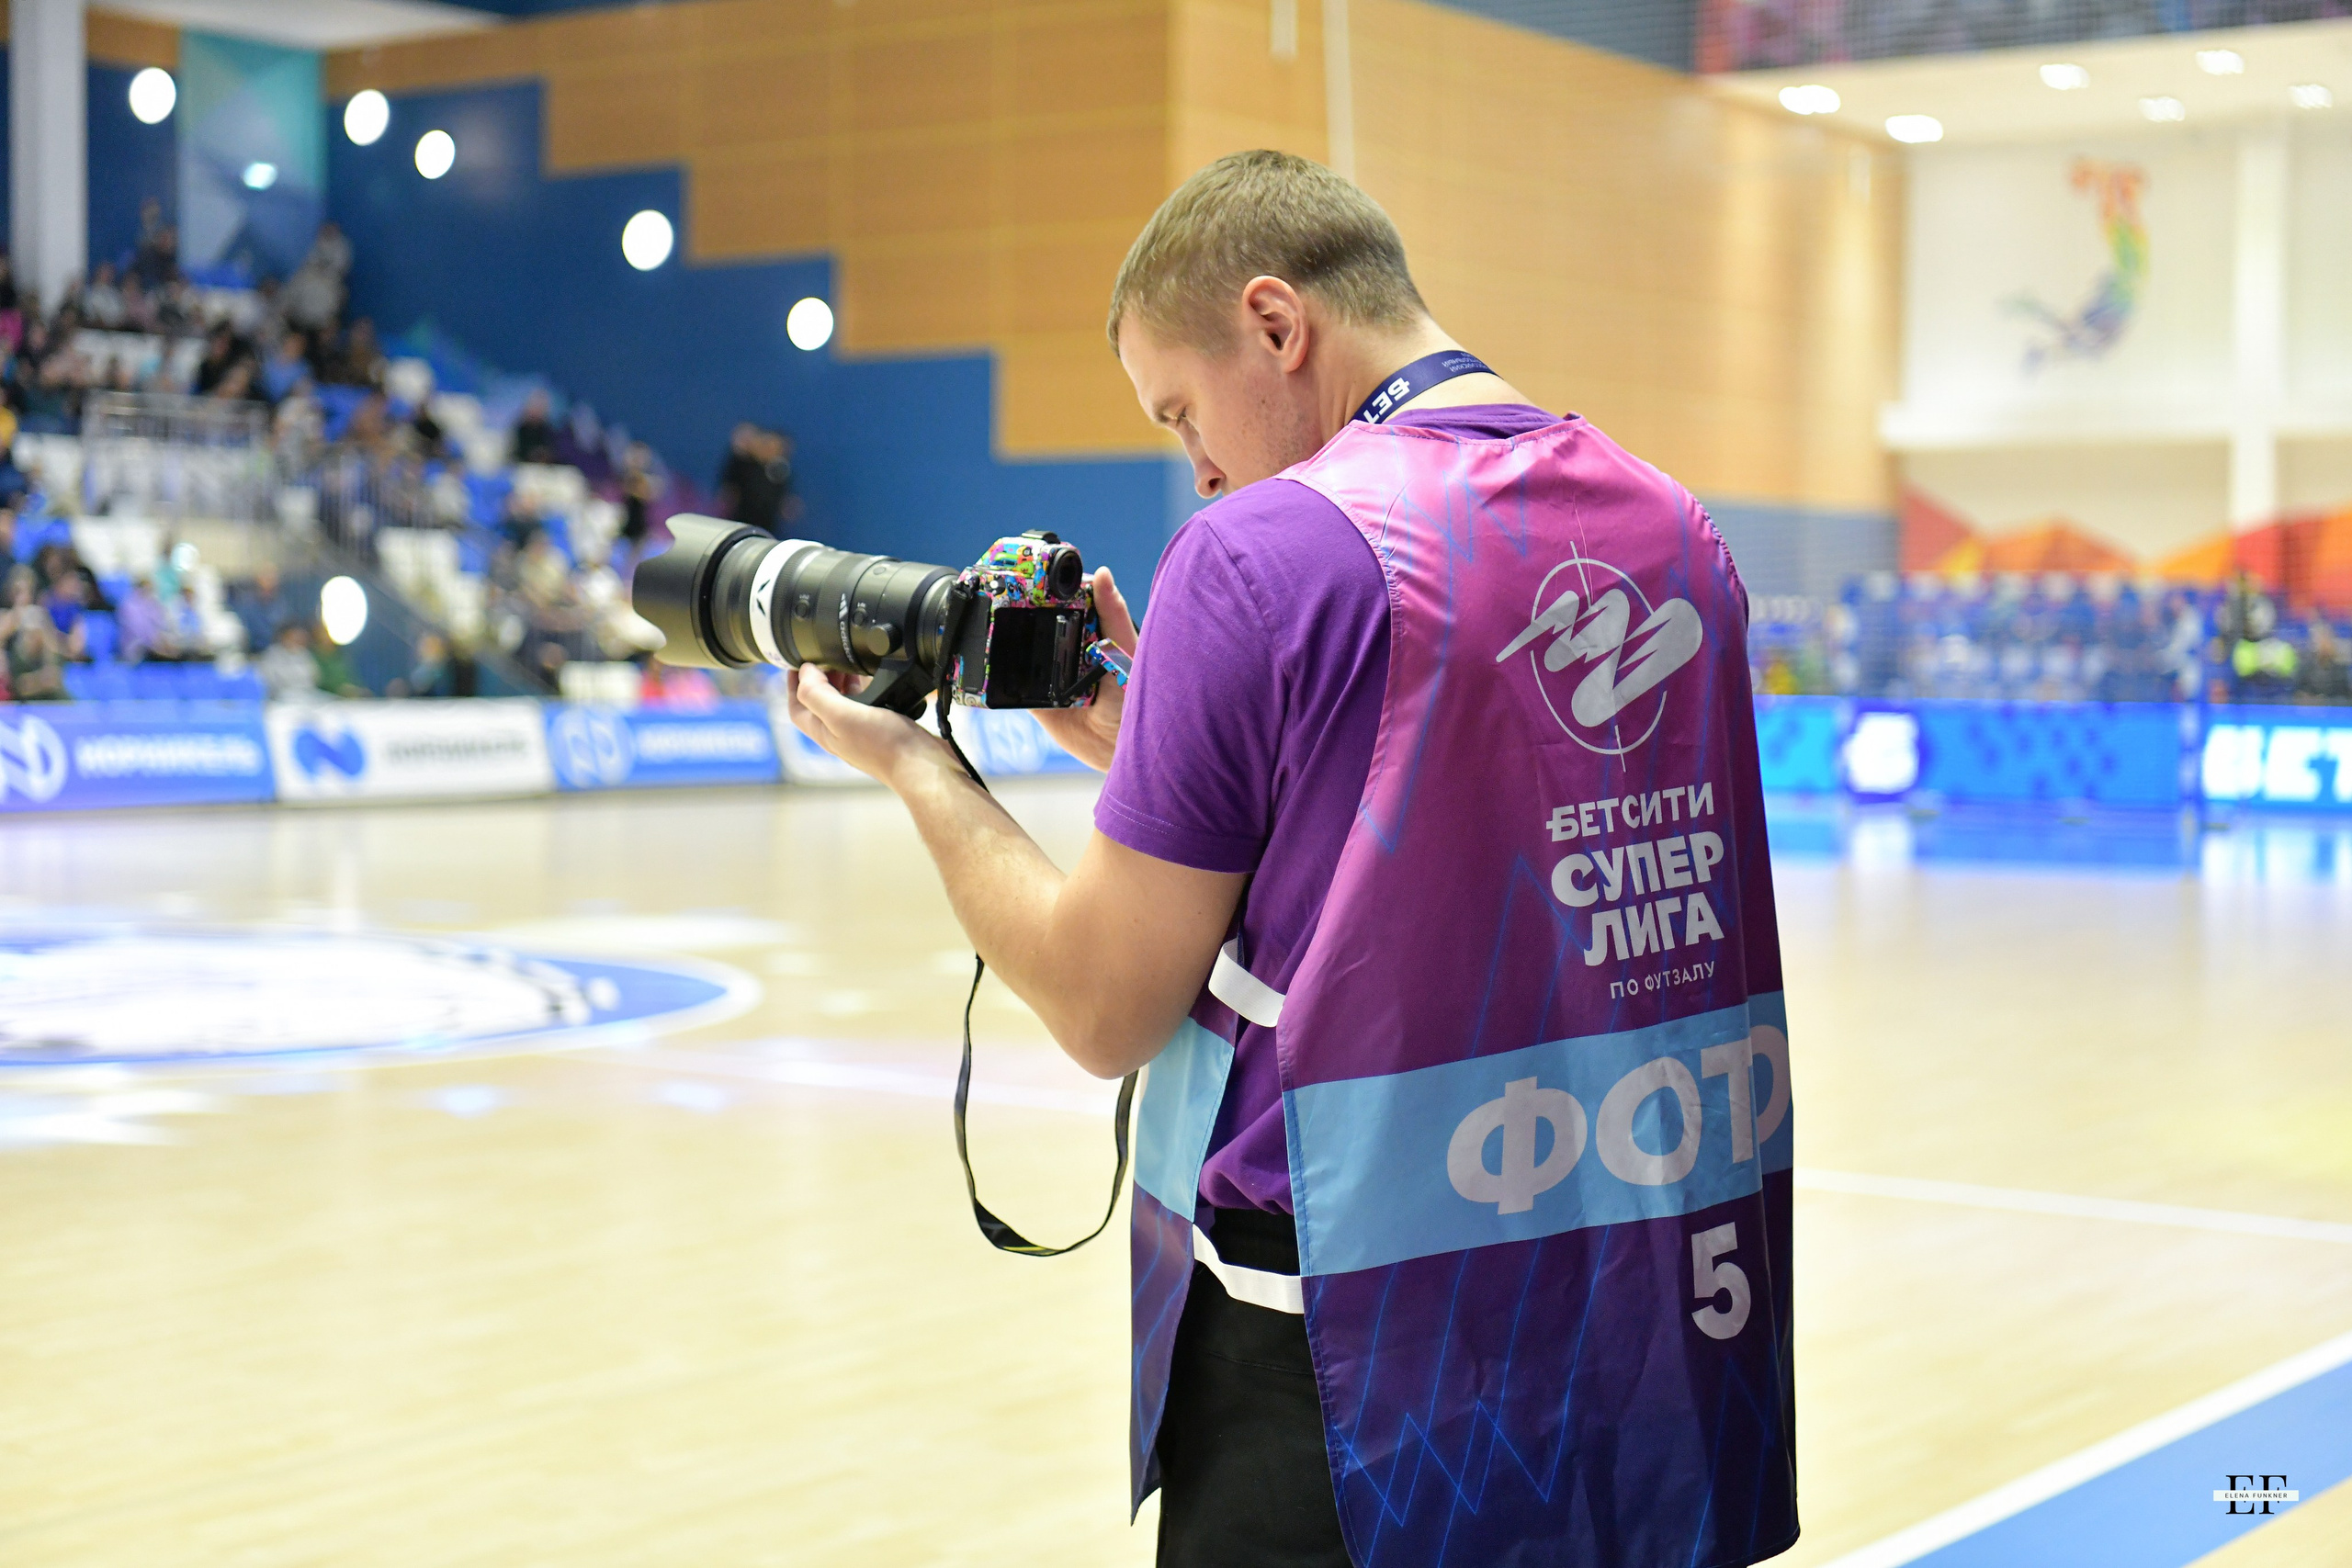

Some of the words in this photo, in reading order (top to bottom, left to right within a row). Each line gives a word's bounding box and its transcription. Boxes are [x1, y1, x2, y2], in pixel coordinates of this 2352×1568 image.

[1546, 782, 1714, 842] БЕТСИТИ
[1551, 830, 1724, 908] СУПЕР
[1583, 892, 1724, 966] ЛИГА
[1610, 979, 1638, 999] ПО
[1644, 961, 1715, 992] ФУТЗАЛУ
[1691, 1222, 1751, 1340] 5
